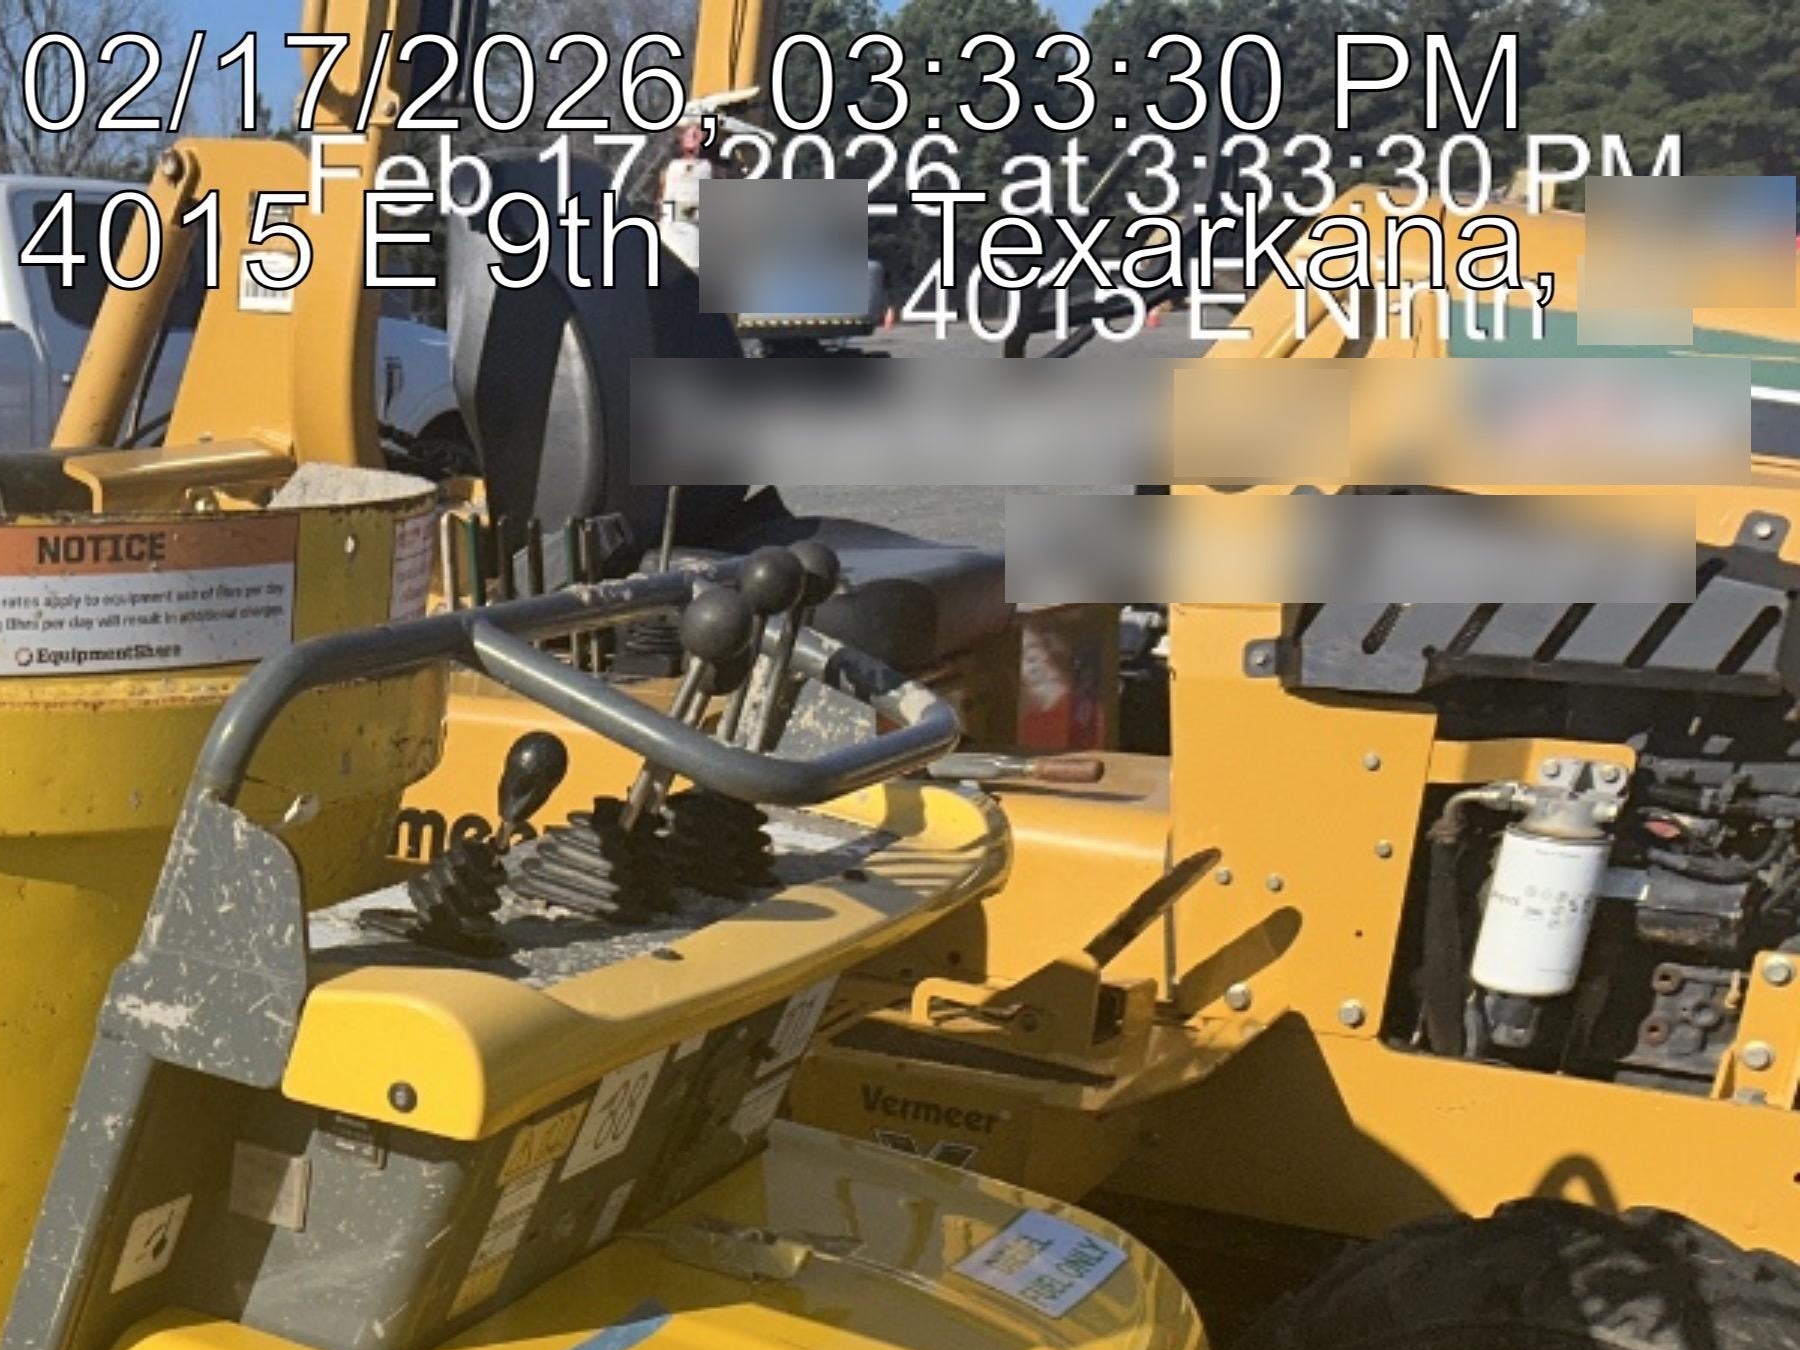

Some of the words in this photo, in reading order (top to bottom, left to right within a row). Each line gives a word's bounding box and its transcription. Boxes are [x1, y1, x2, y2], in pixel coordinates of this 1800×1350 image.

[37, 530, 167, 565] NOTICE
[2, 594, 39, 608] rates
[44, 592, 81, 609] apply
[101, 588, 172, 607] equipment
[42, 617, 65, 632] per
[68, 614, 94, 631] day
[98, 613, 121, 628] will
[123, 610, 162, 626] result
[36, 643, 182, 667] EquipmentShare
[859, 1081, 1001, 1135] Vermeer
[1017, 1273, 1075, 1304] FUEL
[1054, 1235, 1110, 1279] ONLY
